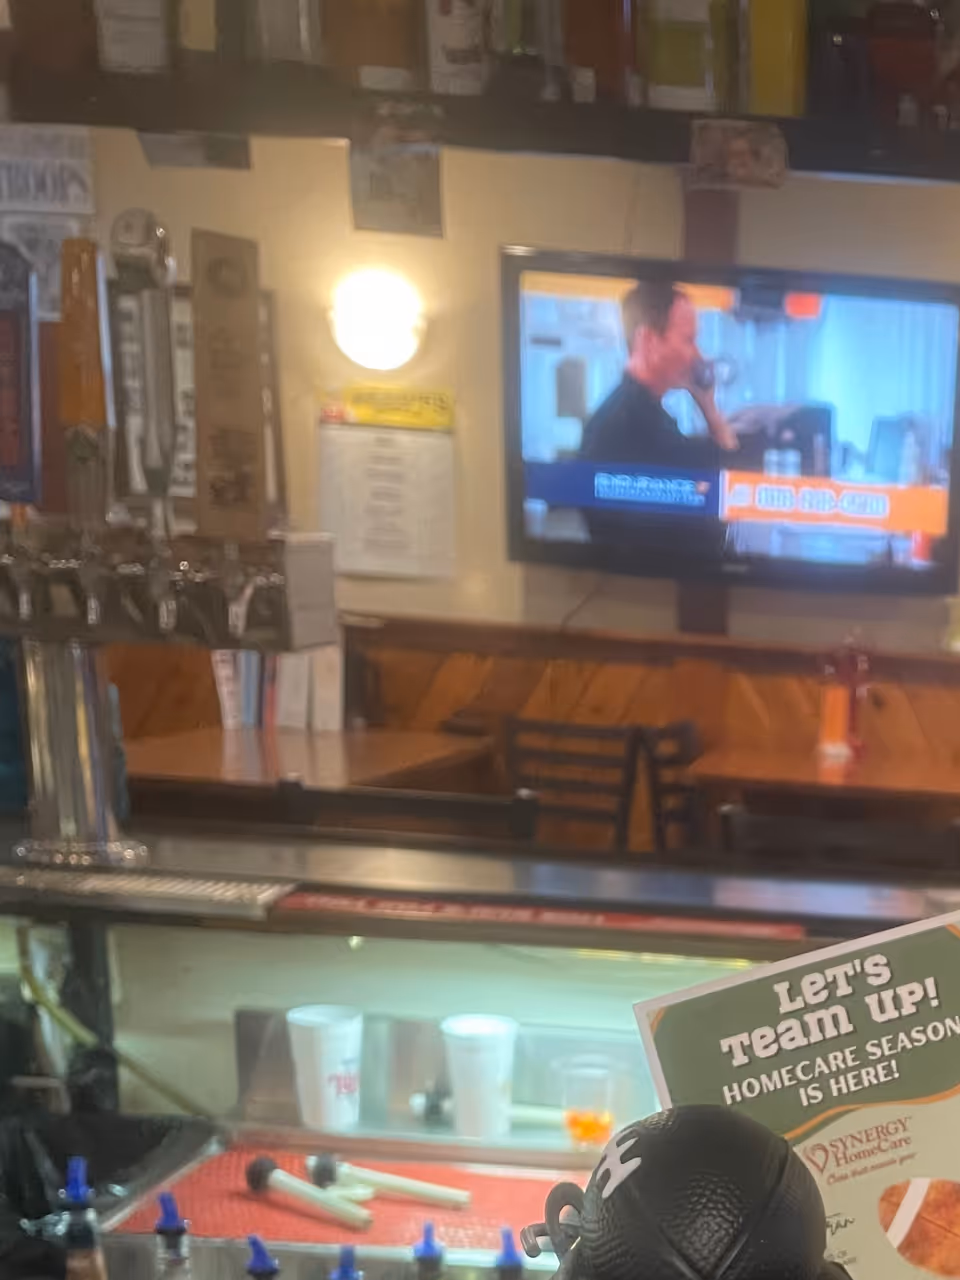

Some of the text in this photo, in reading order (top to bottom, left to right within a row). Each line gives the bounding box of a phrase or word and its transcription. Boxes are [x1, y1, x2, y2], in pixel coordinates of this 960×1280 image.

[722, 1046, 860, 1105] HOMECARE
[799, 1059, 901, 1107] IS HERE!
[829, 1117, 910, 1151] SYNERGY
[832, 1136, 912, 1168] HomeCare
